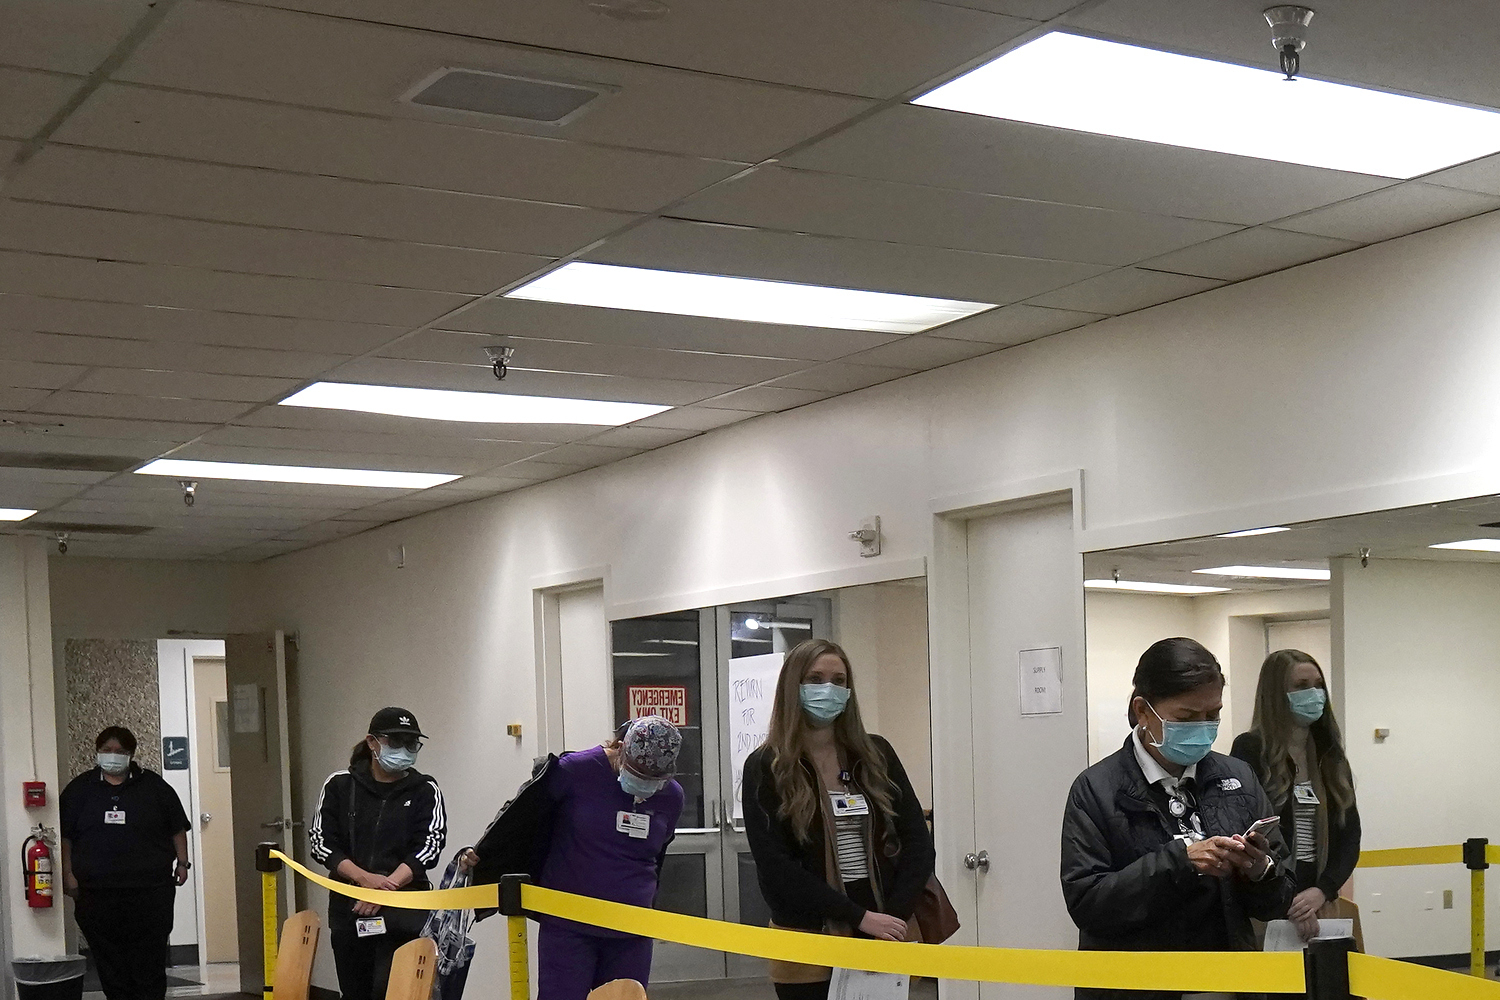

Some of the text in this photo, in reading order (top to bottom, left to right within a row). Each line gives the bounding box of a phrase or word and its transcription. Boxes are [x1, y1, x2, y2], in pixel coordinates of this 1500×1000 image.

[733, 678, 763, 703] RETURN
[742, 707, 756, 726] FOR
[737, 731, 752, 754] 2ND
